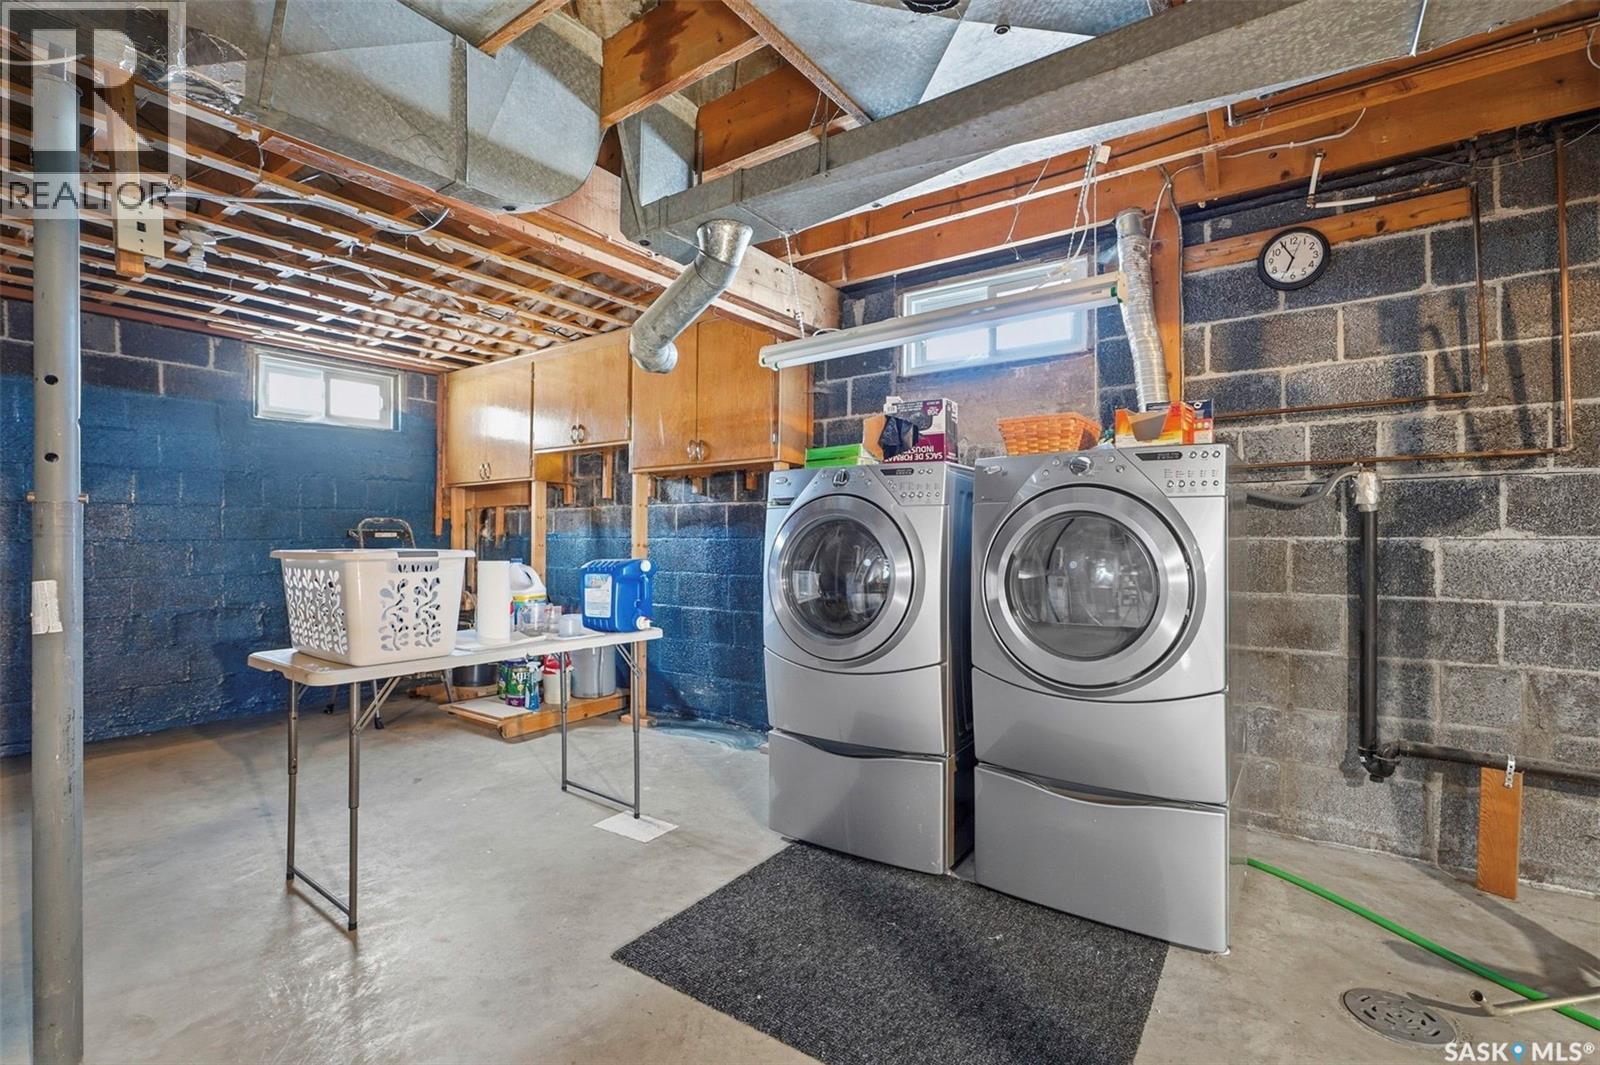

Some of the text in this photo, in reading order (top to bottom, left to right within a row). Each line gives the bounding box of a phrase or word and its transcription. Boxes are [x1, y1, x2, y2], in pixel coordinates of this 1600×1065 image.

[1290, 237, 1298, 245] 12
[1309, 242, 1315, 250] 2
[1272, 248, 1281, 257] 10
[1313, 251, 1319, 259] 3
[1308, 260, 1315, 268] 4
[1290, 272, 1296, 280] 6
[1301, 268, 1307, 276] 5
[915, 453, 924, 461] DE
[925, 451, 943, 460] SACS
